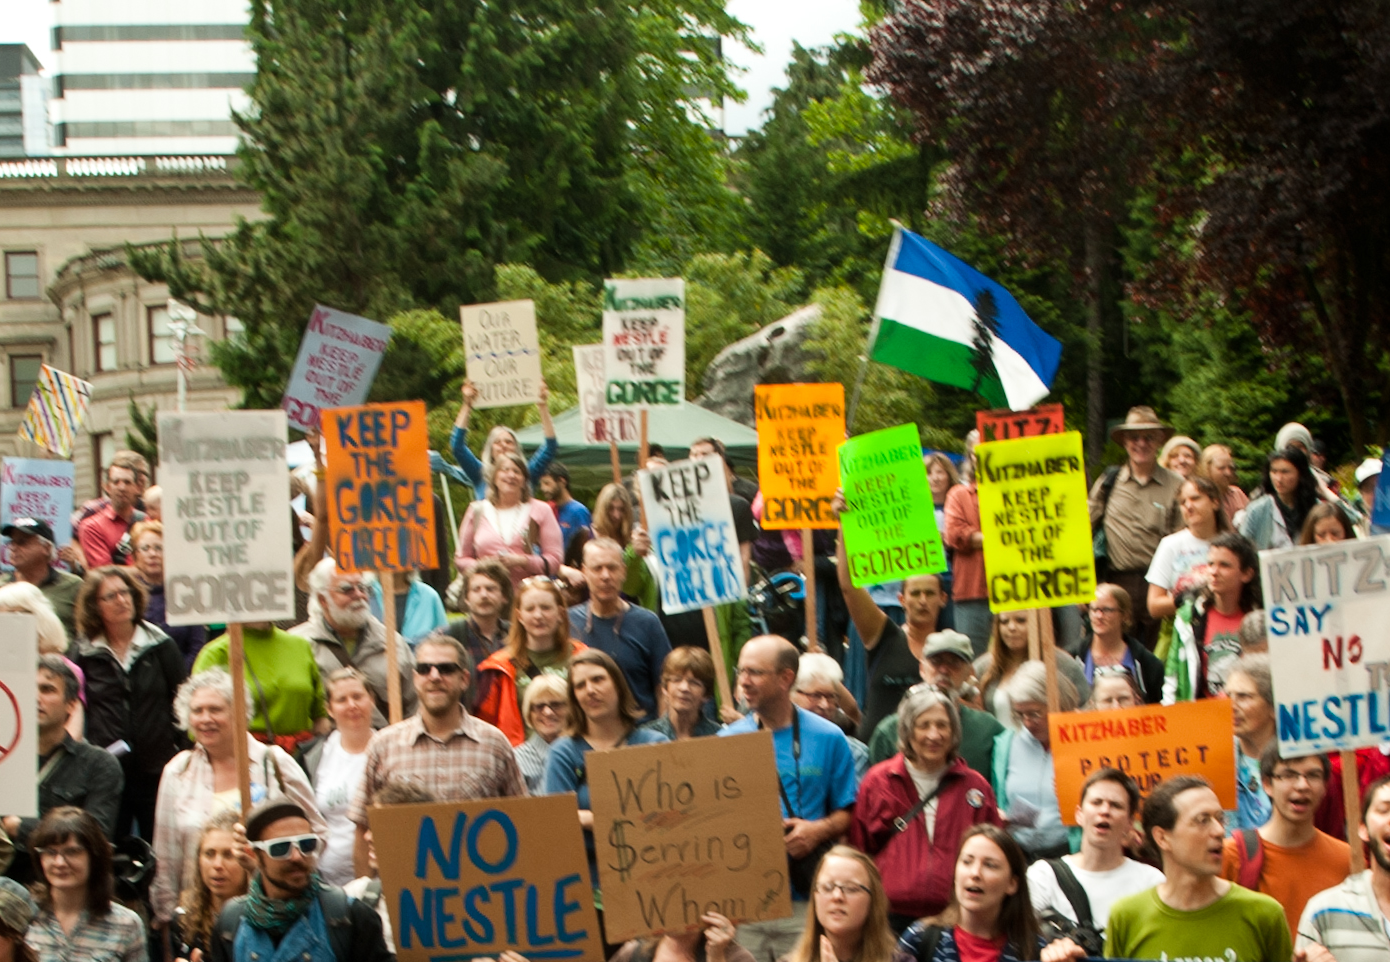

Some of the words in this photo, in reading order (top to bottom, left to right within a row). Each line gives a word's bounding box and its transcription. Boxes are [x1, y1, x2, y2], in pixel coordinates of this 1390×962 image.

[478, 309, 512, 330] OUR
[619, 317, 659, 331] KEEP
[320, 341, 359, 364] KEEP
[468, 329, 522, 352] WATER
[617, 347, 645, 361] OUT
[484, 358, 519, 379] OUR
[629, 363, 658, 377] THE
[304, 369, 337, 390] OUT
[337, 378, 357, 395] OF
[605, 380, 682, 406] GORGE
[315, 387, 344, 406] THE
[336, 409, 411, 449] KEEP
[777, 426, 817, 442] KEEP
[349, 451, 396, 478] THE
[773, 460, 803, 475] OUT
[808, 460, 827, 475] OF
[976, 452, 1080, 484] KITZHABER
[188, 470, 250, 494] KEEP
[649, 461, 710, 504] KEEP
[789, 477, 817, 491] THE
[853, 472, 896, 494] KEEP
[16, 491, 50, 502] KEEP
[336, 478, 429, 525] GORGE
[764, 496, 838, 522] GORG
[1001, 486, 1051, 508] KEEP
[664, 499, 706, 529] THE
[857, 509, 888, 529] OUT
[892, 503, 912, 522] OF
[183, 520, 229, 543] OUT
[234, 519, 264, 541] OF
[655, 521, 729, 567] GORGE
[874, 523, 906, 543] THE
[1000, 527, 1036, 547] OUT
[1043, 523, 1066, 542] OF
[203, 543, 249, 566] THE
[336, 525, 431, 571] GORGEOUS
[850, 539, 940, 579] GORGE
[1019, 543, 1055, 563] THE
[167, 571, 288, 616] GORGE
[991, 565, 1092, 604] GORGE
[1269, 603, 1332, 637] SAY
[1321, 634, 1363, 670] NO
[1057, 714, 1168, 744] KITZHABER
[1079, 745, 1209, 776] PROTECT
[610, 759, 695, 816] Who
[713, 775, 742, 800] is
[1131, 773, 1162, 793] UR
[415, 808, 519, 880] NO
[398, 873, 588, 949] NESTLE
